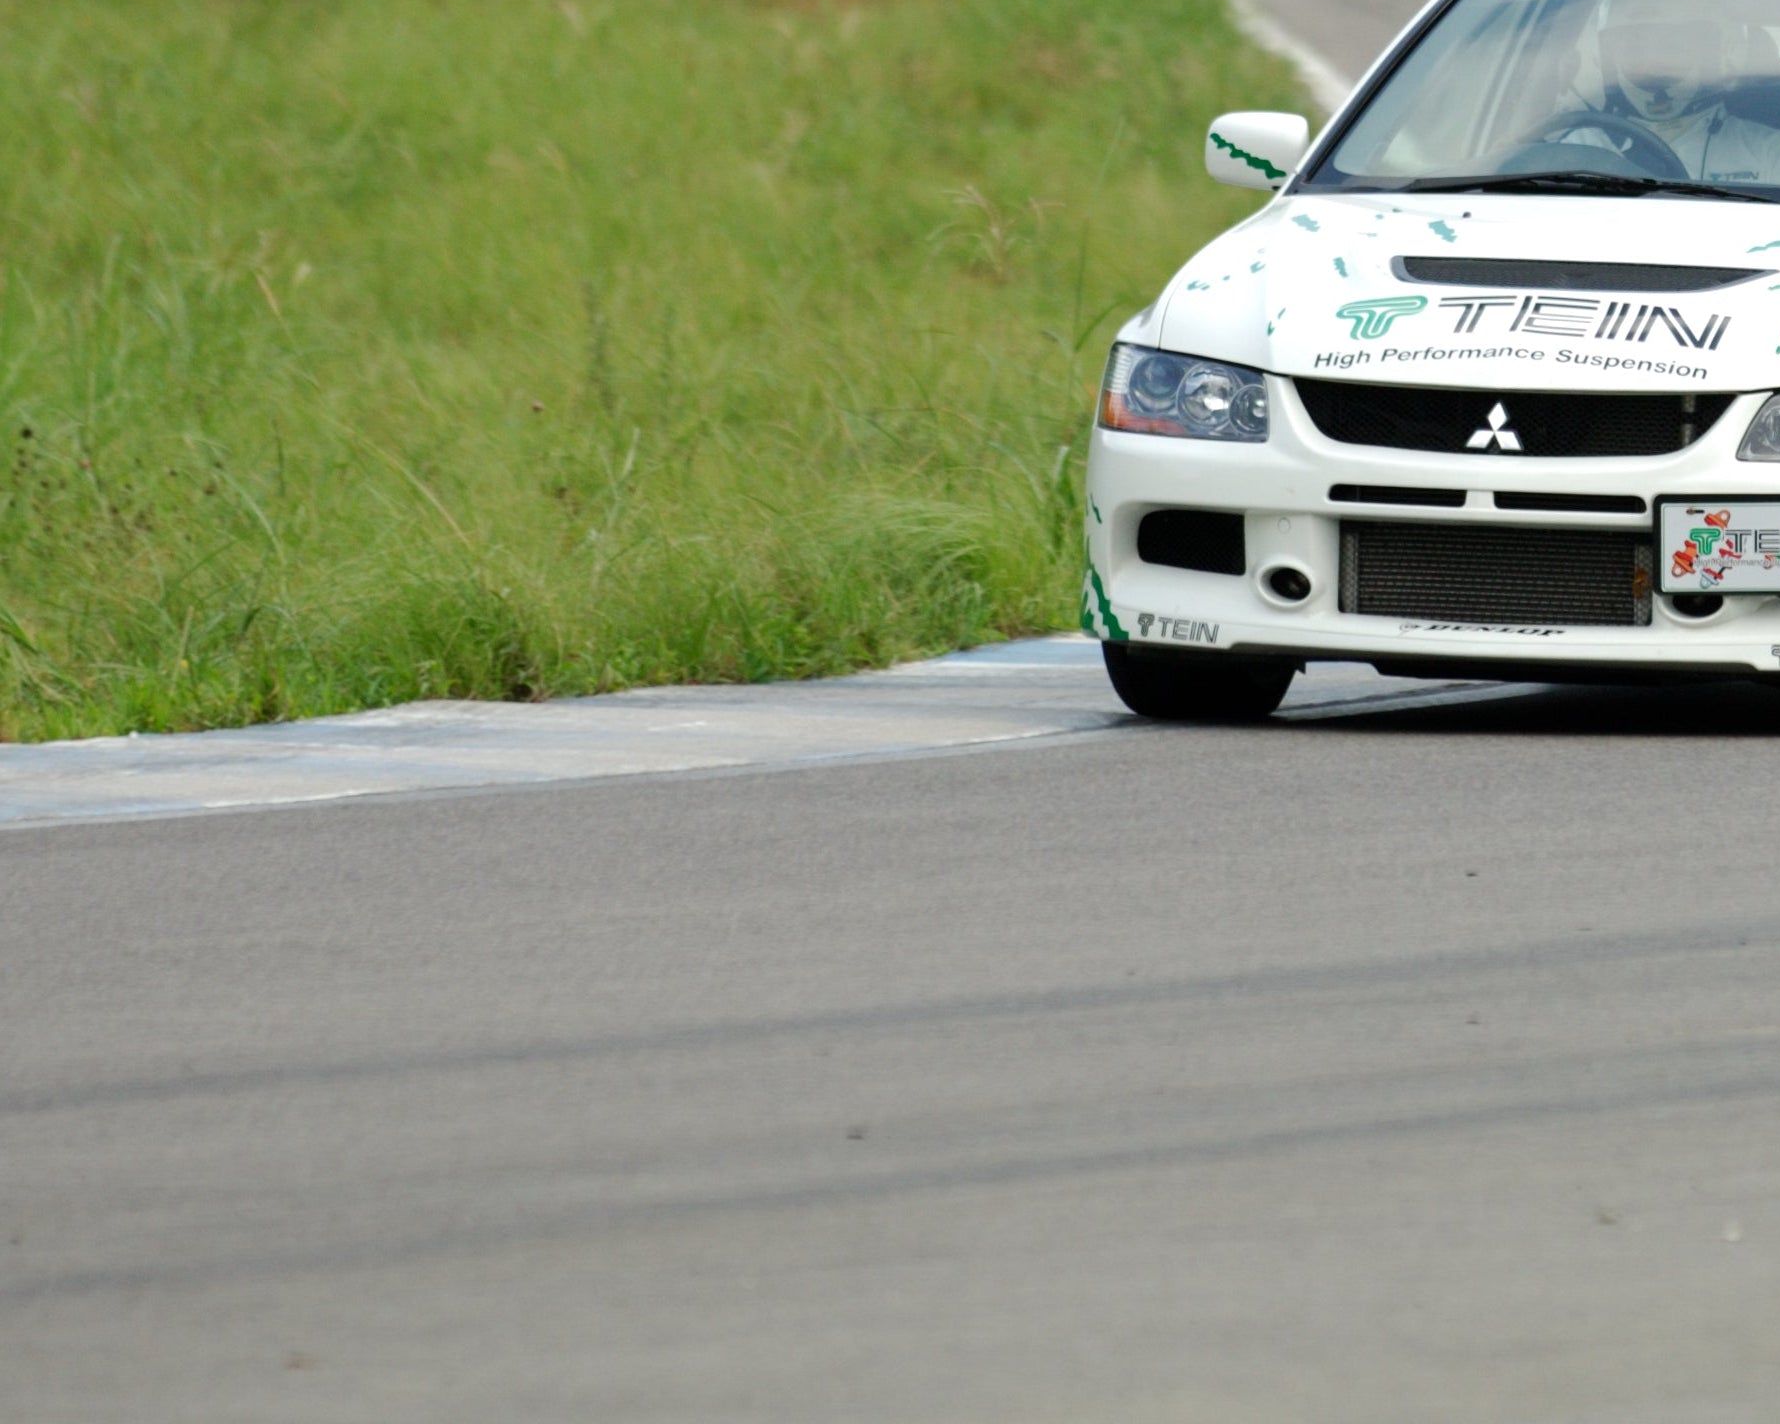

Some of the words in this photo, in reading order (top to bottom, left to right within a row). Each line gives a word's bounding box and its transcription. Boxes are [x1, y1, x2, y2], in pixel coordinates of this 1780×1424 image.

[1438, 294, 1732, 351] TEIN
[1314, 349, 1371, 370] High
[1381, 347, 1545, 363] Performance
[1555, 349, 1708, 379] Suspension
[1158, 616, 1219, 643] TEIN
[1423, 624, 1566, 636] DUNLOP
